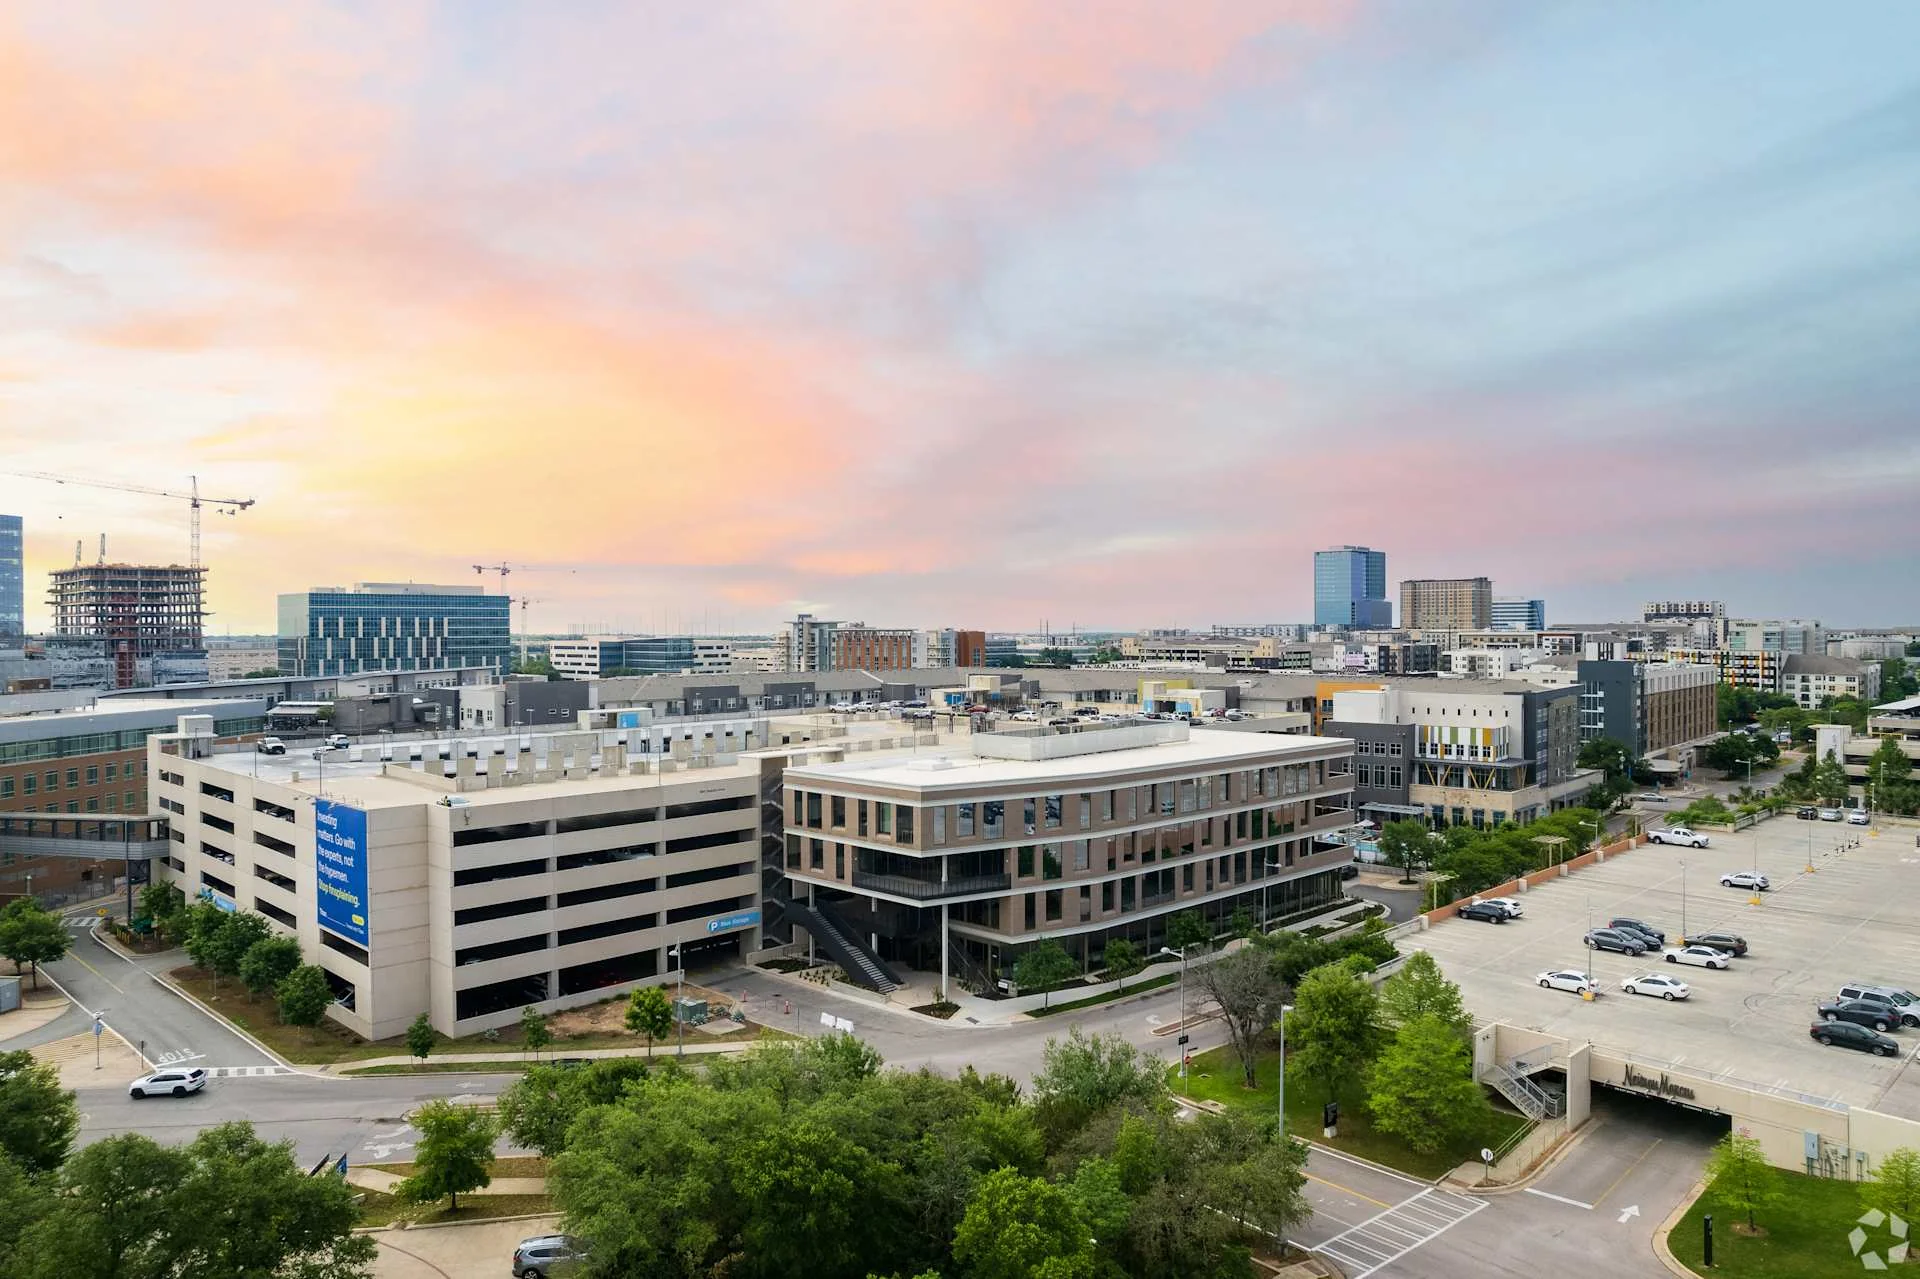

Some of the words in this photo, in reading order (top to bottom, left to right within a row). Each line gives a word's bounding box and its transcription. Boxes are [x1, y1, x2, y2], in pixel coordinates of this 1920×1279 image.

[335, 833, 343, 846] Go
[343, 836, 356, 850] with
[344, 856, 354, 868] not
[159, 1048, 194, 1063] STOP
